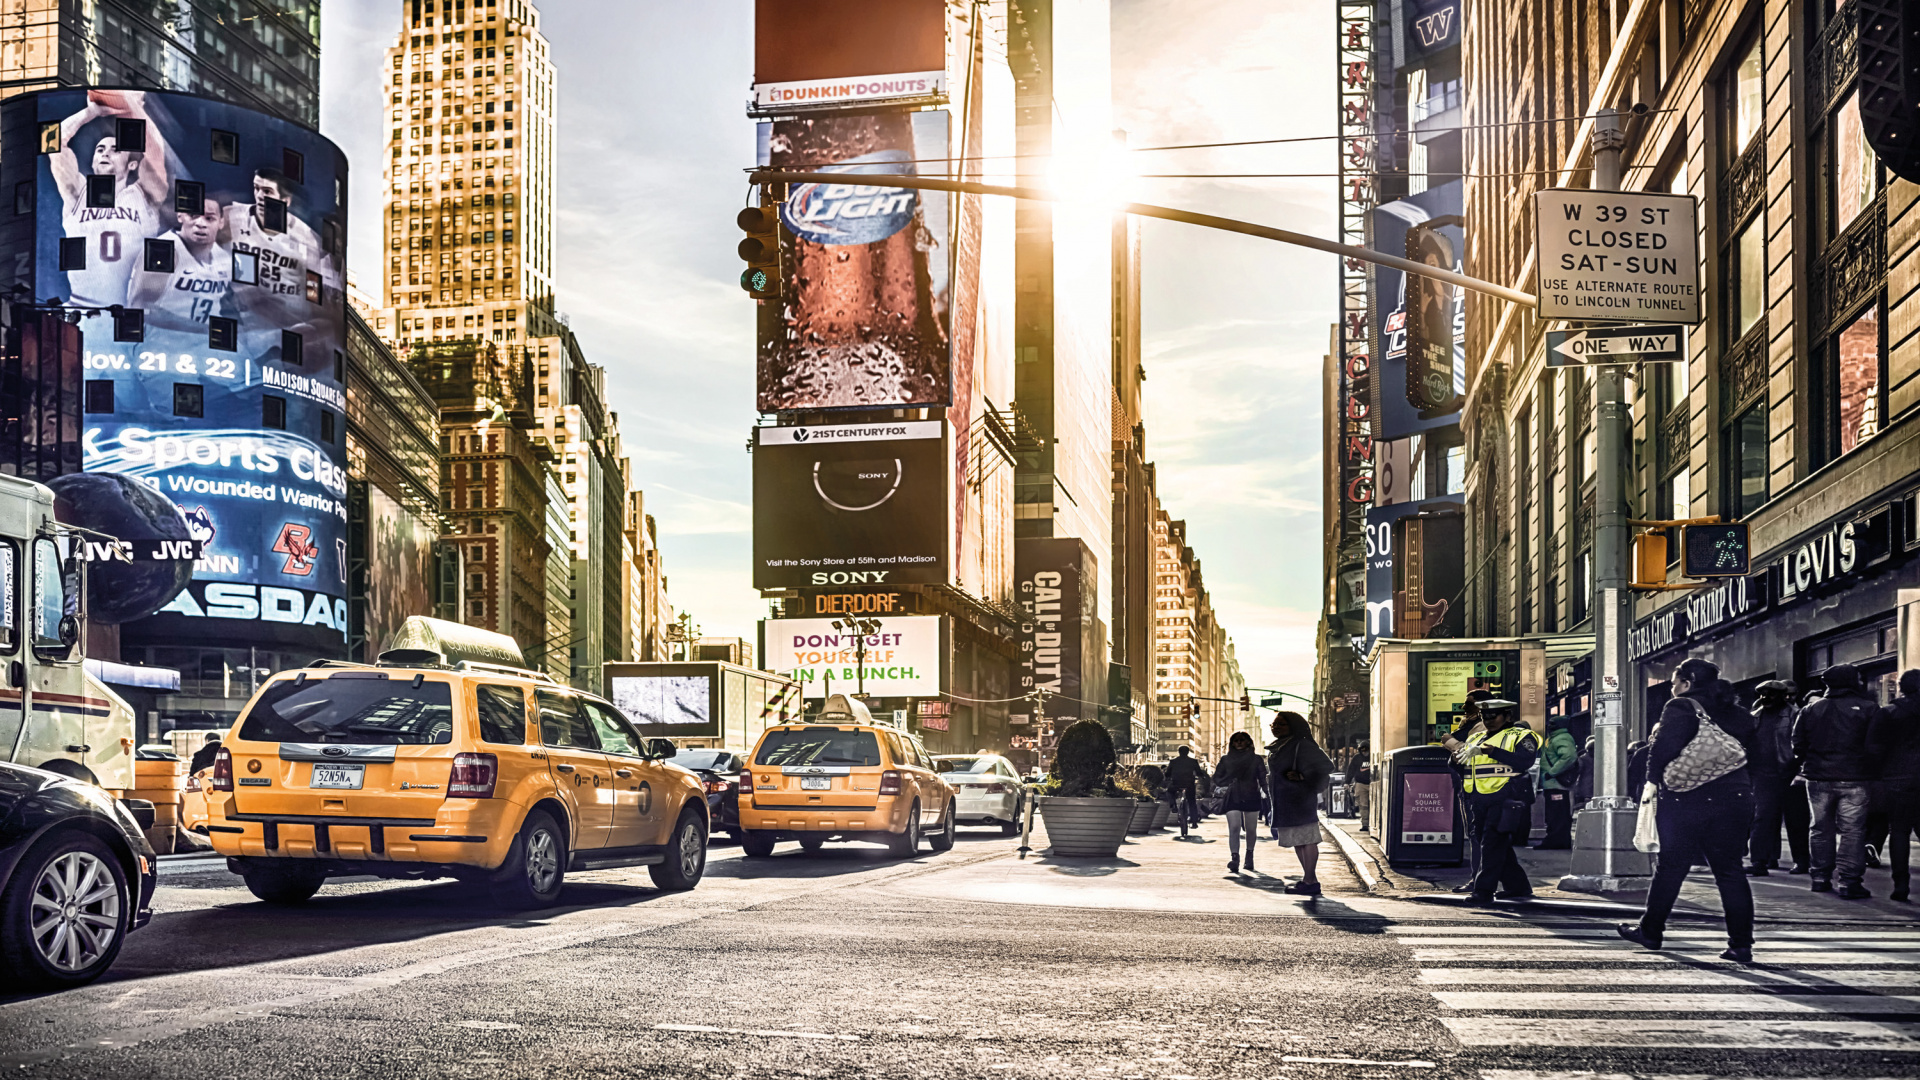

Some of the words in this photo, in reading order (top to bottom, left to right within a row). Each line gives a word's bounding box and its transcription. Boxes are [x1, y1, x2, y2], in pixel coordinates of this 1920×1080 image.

[1416, 6, 1454, 47] W
[79, 206, 141, 225] INDIANA
[802, 193, 914, 222] LIGHT
[1563, 203, 1581, 221] W
[1595, 205, 1627, 223] 39
[1640, 208, 1670, 225] ST
[100, 231, 121, 262] 0
[1568, 229, 1667, 250] CLOSED
[259, 262, 281, 282] 25
[1560, 253, 1677, 275] SAT-SUN
[174, 277, 231, 293] UCONN
[1543, 279, 1568, 290] USE
[1575, 280, 1647, 294] ALTERNATE
[1654, 284, 1693, 296] ROUTE
[1553, 295, 1568, 306] TO
[1576, 296, 1630, 308] LINCOLN
[1637, 299, 1686, 310] TUNNEL
[1430, 343, 1445, 356] SEE
[1572, 339, 1609, 354] ONE
[1629, 336, 1668, 351] WAY
[1422, 349, 1437, 361] THE
[139, 352, 167, 372] 21
[175, 354, 197, 375] &
[205, 358, 236, 379] 22
[262, 366, 310, 393] MADISON
[311, 378, 337, 404] SQUARE
[812, 429, 835, 438] 21ST
[835, 428, 886, 438] CENTURY
[886, 427, 906, 435] FOX
[118, 428, 279, 473] Sports
[168, 474, 276, 500] Wounded
[281, 487, 334, 513] Warrior
[152, 541, 194, 560] JVC
[800, 558, 821, 566] Sony
[878, 556, 896, 564] and
[898, 556, 936, 564] Madison
[812, 571, 889, 585] SONY
[1045, 622, 1055, 631] OF
[1627, 625, 1650, 662] BUBBA
[1651, 611, 1674, 651] GUMP
[1686, 586, 1726, 636] SHRIMP
[1728, 576, 1749, 618] CO.
[866, 634, 902, 646] GET
[794, 650, 894, 665] YOURSELF
[1034, 632, 1061, 694] DUTY
[793, 668, 814, 681] IN
[822, 668, 836, 681] A
[843, 667, 920, 680] BUNCH.
